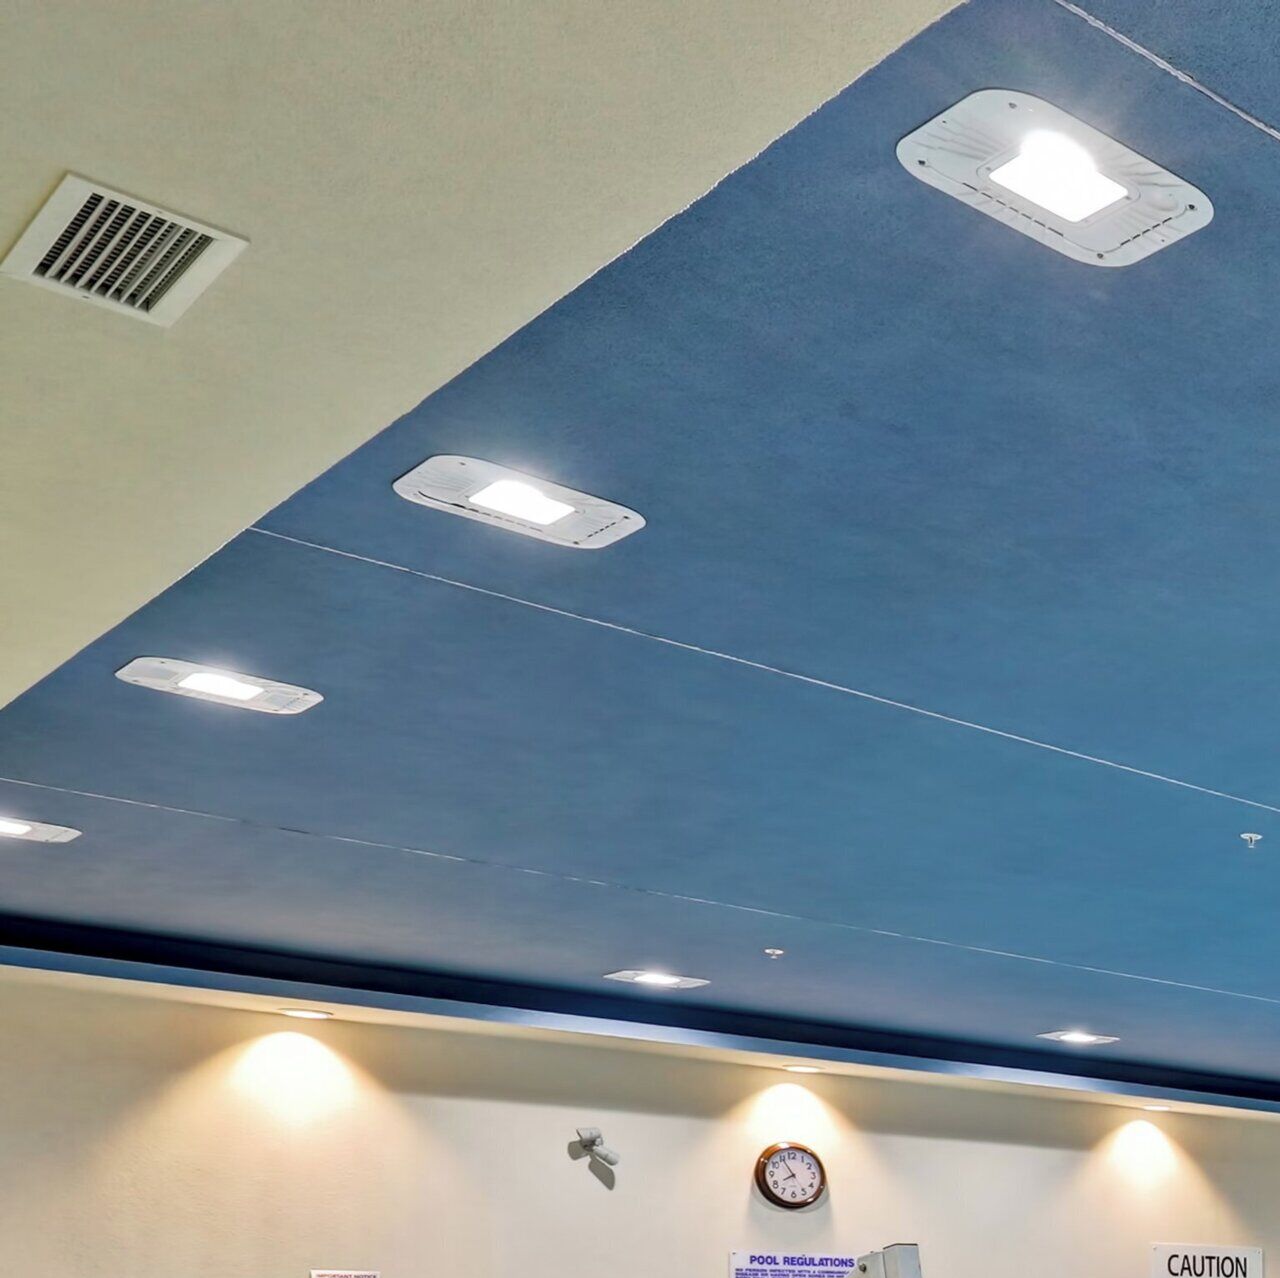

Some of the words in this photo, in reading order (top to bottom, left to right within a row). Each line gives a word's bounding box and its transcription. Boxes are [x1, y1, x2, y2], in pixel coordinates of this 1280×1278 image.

[788, 1152, 797, 1160] 12
[771, 1161, 779, 1169] 10
[806, 1162, 812, 1170] 2
[769, 1170, 774, 1178] 9
[811, 1172, 816, 1180] 3
[773, 1180, 779, 1189] 8
[781, 1187, 786, 1195] 7
[801, 1188, 807, 1196] 5
[750, 1255, 780, 1266] POOL
[783, 1256, 855, 1267] REGULATIONS
[1167, 1254, 1247, 1278] CAUTION
